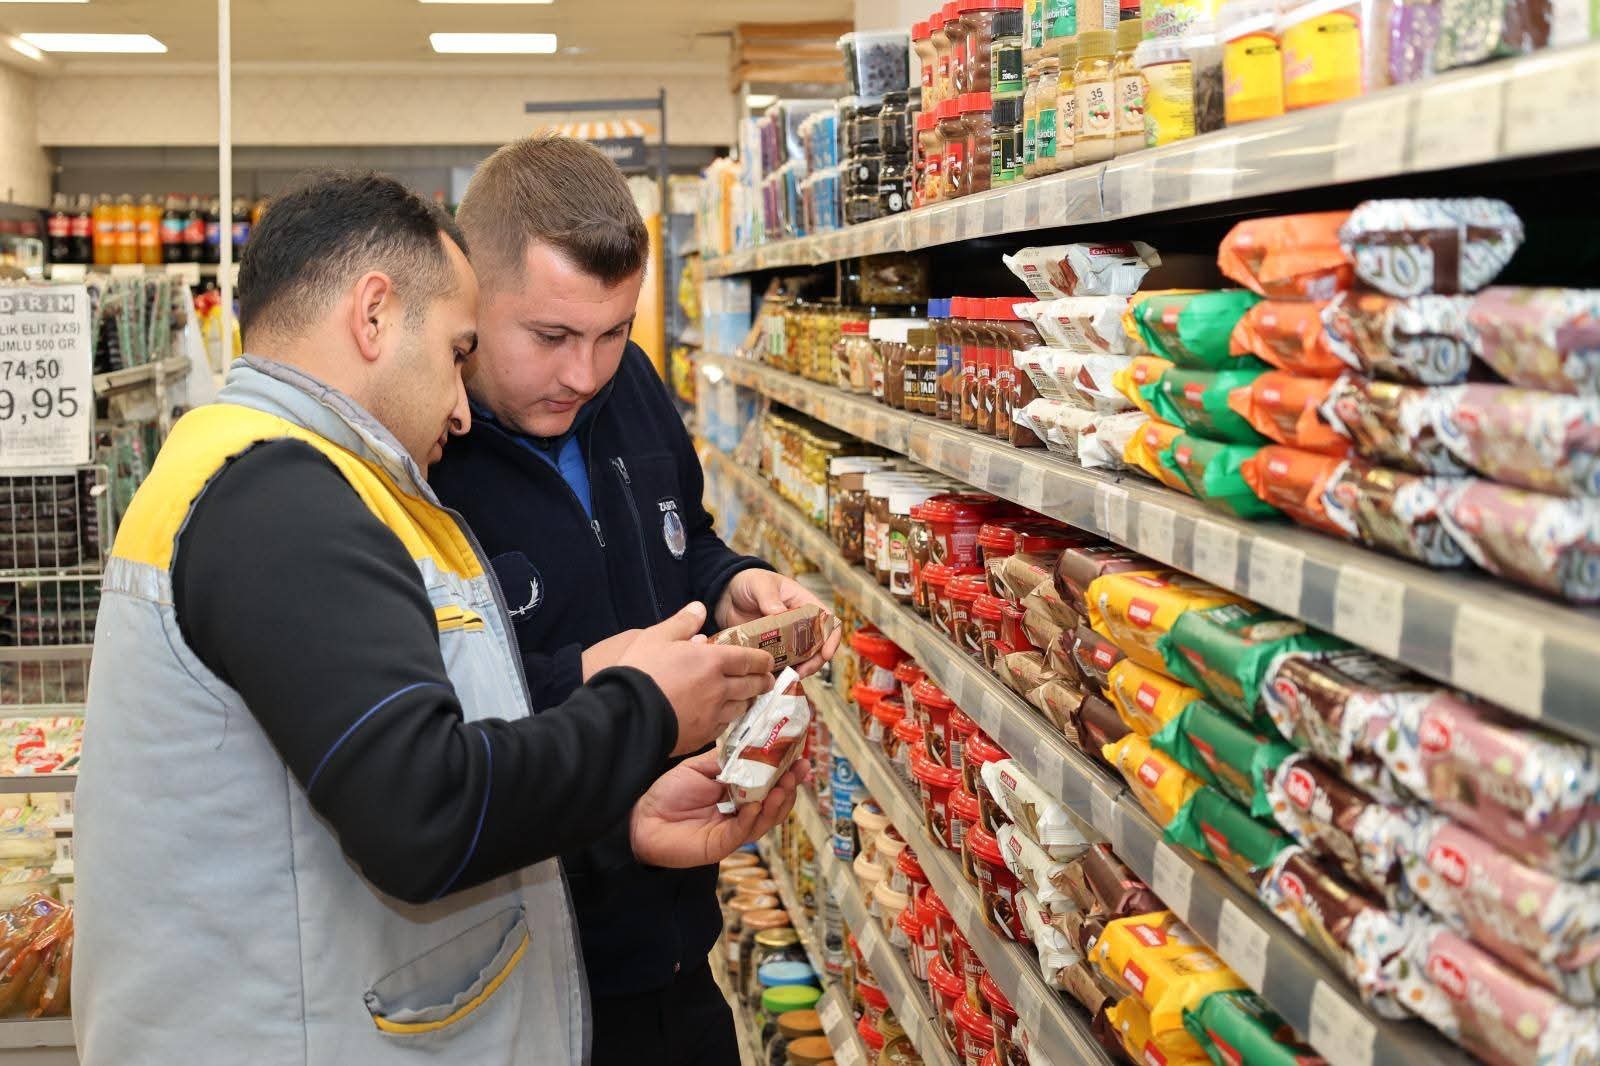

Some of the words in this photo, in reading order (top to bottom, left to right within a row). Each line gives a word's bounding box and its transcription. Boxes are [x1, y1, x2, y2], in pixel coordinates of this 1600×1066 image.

[1091, 88, 1103, 100] 35
[1127, 82, 1138, 94] 35
[35, 339, 54, 350] 500
[58, 338, 76, 349] GR
